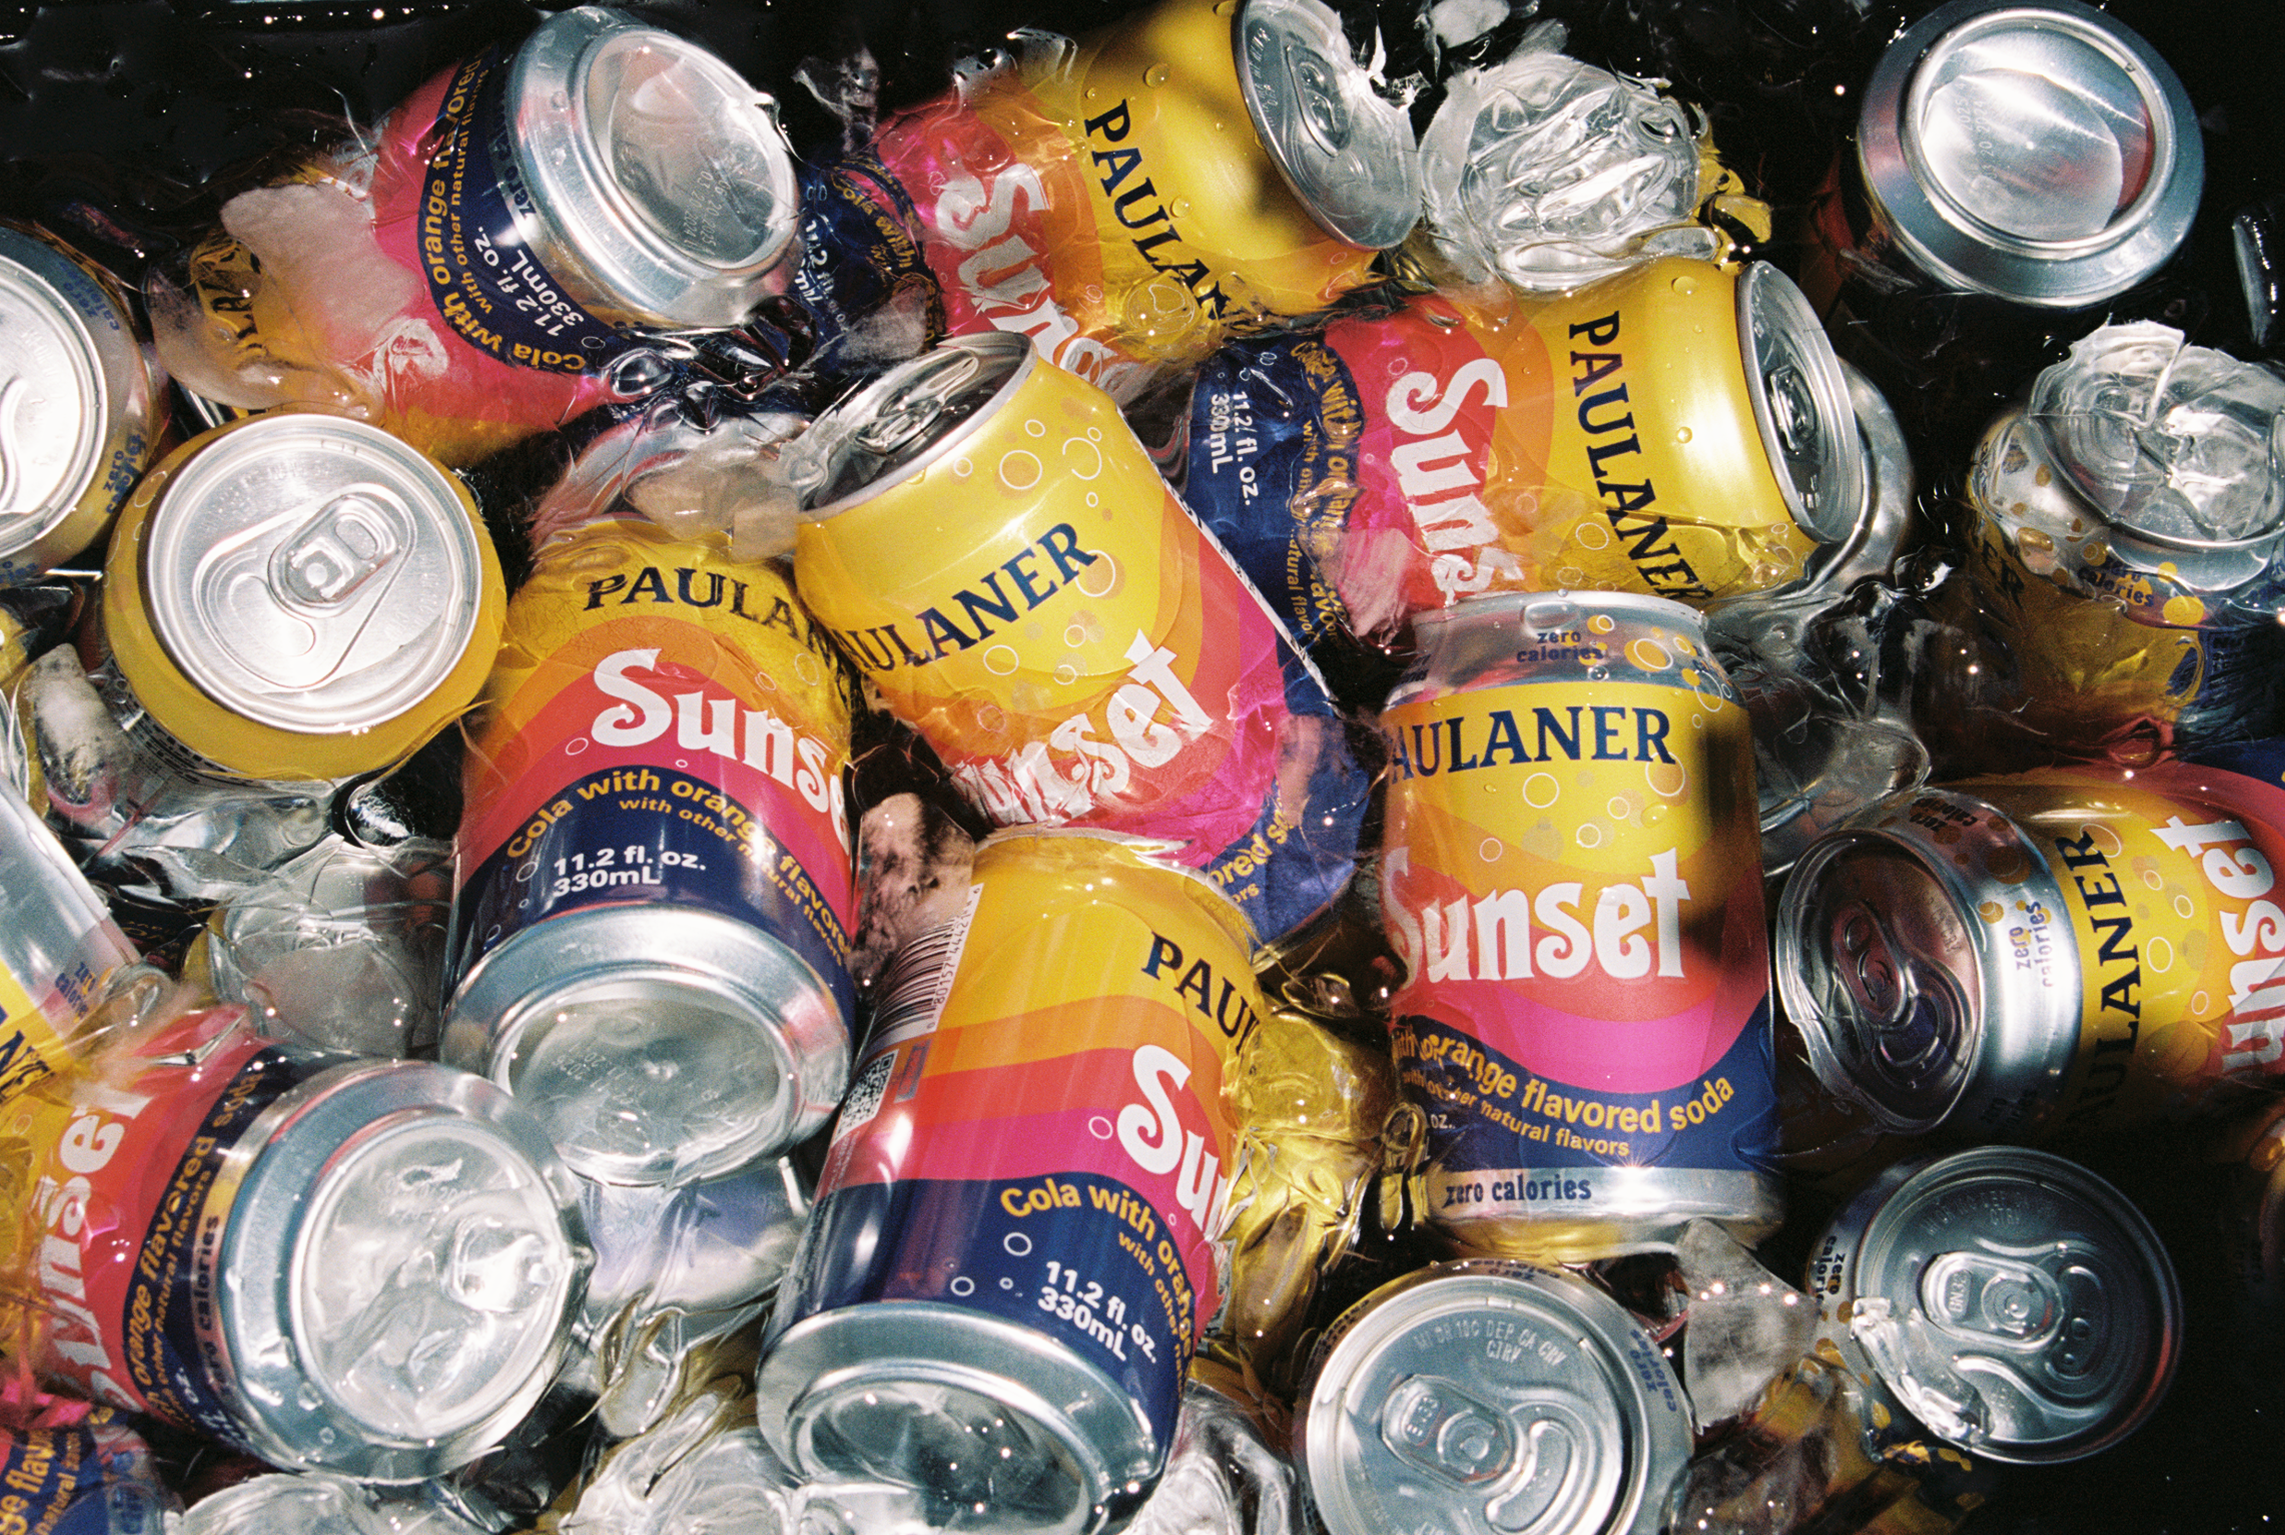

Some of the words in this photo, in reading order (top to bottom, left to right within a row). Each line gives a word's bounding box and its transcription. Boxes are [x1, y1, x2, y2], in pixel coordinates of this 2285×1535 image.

[450, 130, 470, 206] natural
[504, 165, 537, 221] zero
[424, 179, 451, 285] orange
[450, 212, 468, 266] other
[474, 226, 500, 267] oz.
[461, 271, 493, 314] with
[496, 268, 520, 294] fl.
[511, 249, 585, 327] 330mL
[443, 291, 503, 352] with
[515, 294, 565, 337] 11.2
[513, 342, 586, 370] Cola
[1210, 393, 1234, 474] 330mL
[102, 450, 125, 492] zero
[1239, 467, 1259, 506] oz.
[1385, 357, 1526, 607] Suns
[834, 522, 1099, 671] AULANER
[1286, 528, 1305, 591] atural
[1296, 594, 1321, 644] flavor
[1516, 645, 1606, 662] calories
[1536, 630, 1582, 644] zero
[591, 648, 850, 857] Sunse
[949, 628, 1214, 828] unset
[619, 797, 672, 814] with
[678, 809, 737, 842] other
[507, 799, 574, 858] Cola
[577, 769, 660, 801] with
[671, 780, 778, 856] orange
[779, 855, 852, 954] flavore
[552, 866, 661, 897] 330mL
[554, 848, 615, 876] 11.2
[624, 845, 653, 864] fl.
[661, 850, 706, 871] oz.
[2009, 925, 2032, 971] zero
[2025, 901, 2054, 988] calories
[2149, 815, 2285, 1073] unset
[1481, 1099, 1550, 1143] natural
[1556, 1127, 1629, 1157] flavors
[1521, 1078, 1662, 1133] flavored
[1669, 1074, 1735, 1131] soda
[139, 1136, 217, 1282] flavored
[1441, 1181, 1484, 1209] zero
[1491, 1174, 1592, 1202] calories
[154, 1252, 178, 1333] natural
[194, 1215, 220, 1331] calories
[1001, 1178, 1082, 1217] Cola
[1088, 1184, 1157, 1242] with
[1157, 1240, 1193, 1358] orange
[1118, 1231, 1155, 1277] with
[1155, 1279, 1178, 1336] other
[1812, 1235, 1837, 1300] calori
[1827, 1253, 1847, 1296] zero
[128, 1283, 152, 1386] orange
[1038, 1286, 1127, 1362] 330mL
[1046, 1261, 1103, 1309] 11.2
[1107, 1296, 1128, 1332] fl.
[1131, 1323, 1157, 1364] oz.
[1486, 1319, 1515, 1341] DEP
[1518, 1328, 1538, 1350] CA
[1629, 1328, 1678, 1412] calories
[1629, 1349, 1659, 1393] zero
